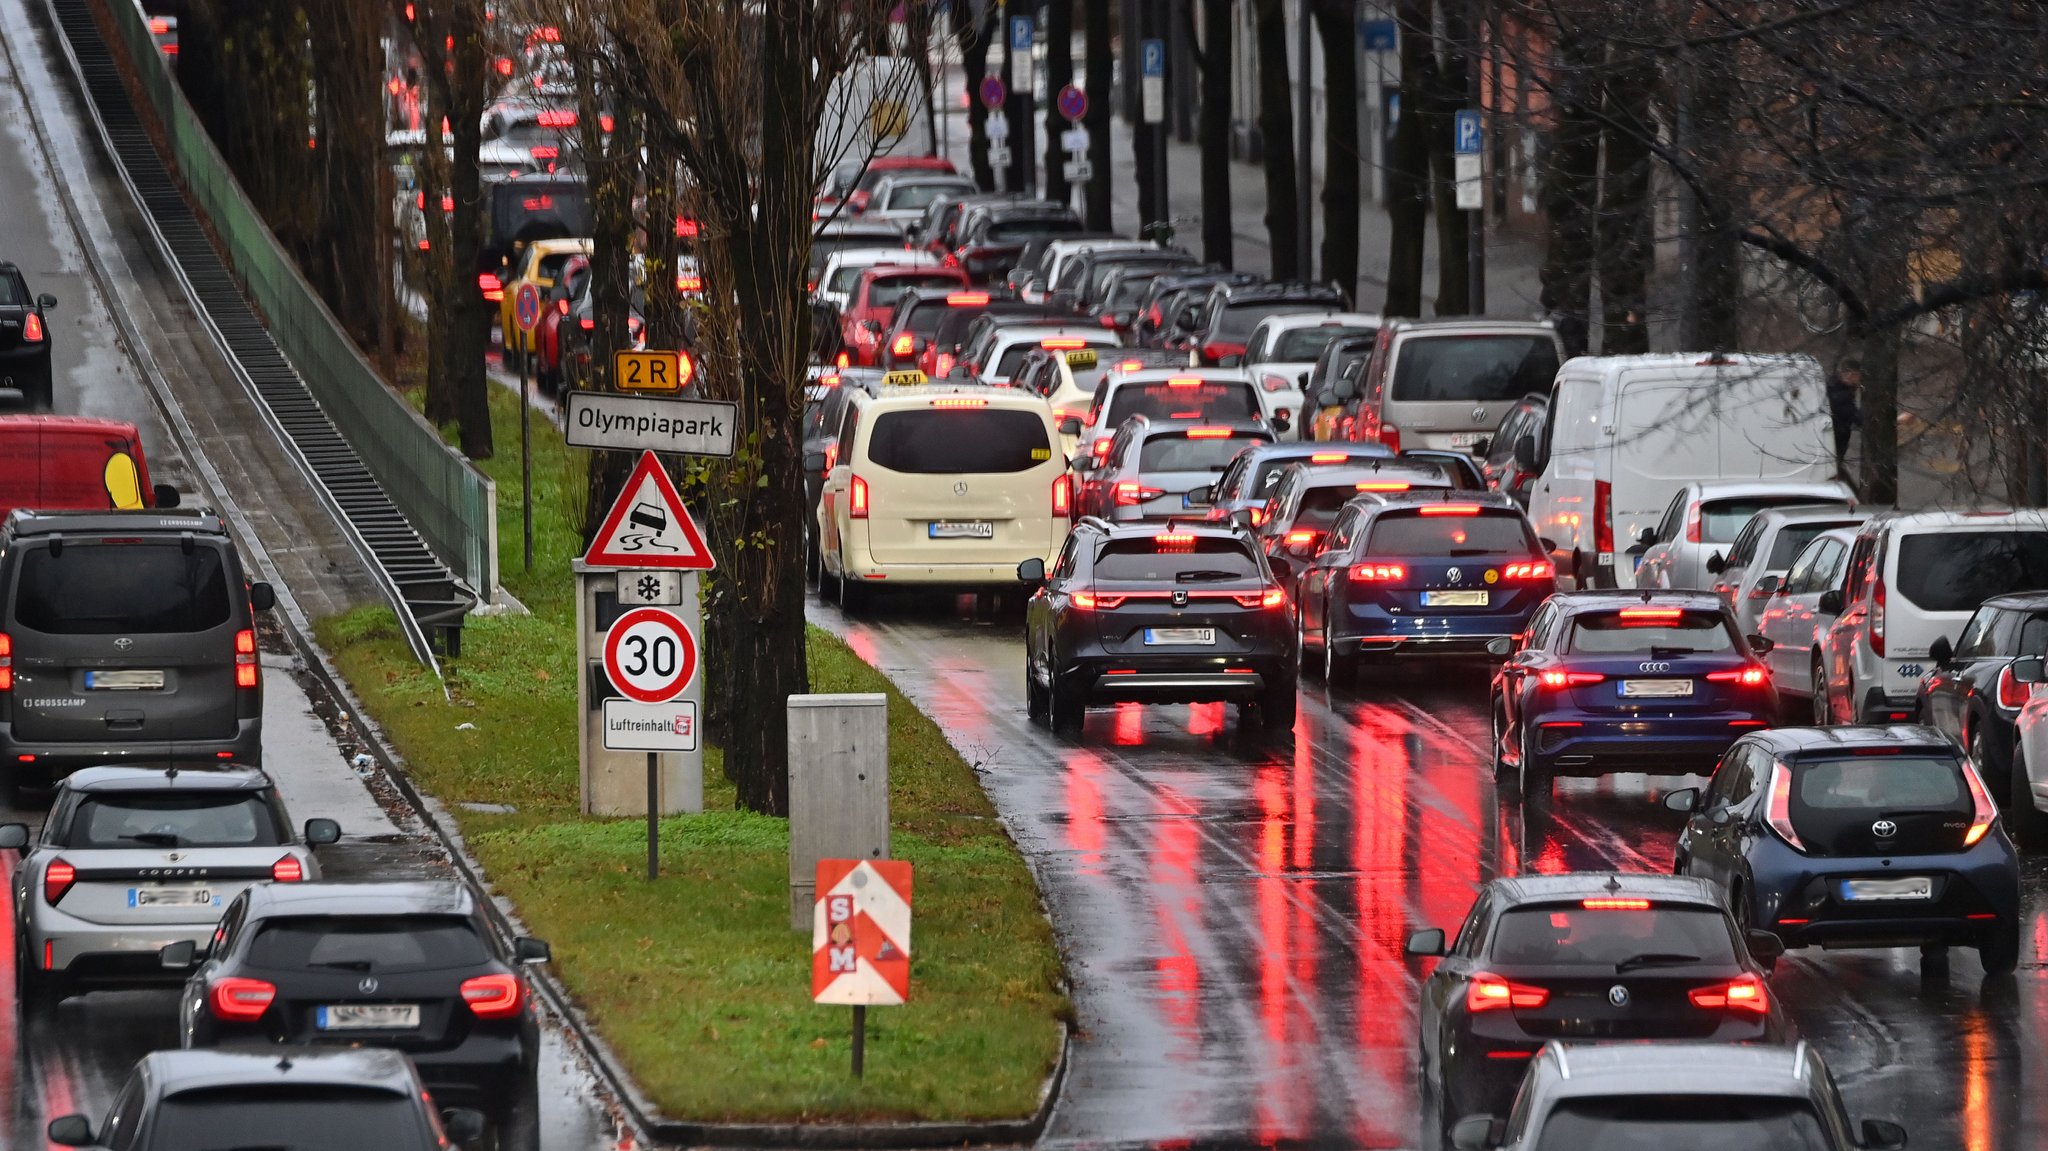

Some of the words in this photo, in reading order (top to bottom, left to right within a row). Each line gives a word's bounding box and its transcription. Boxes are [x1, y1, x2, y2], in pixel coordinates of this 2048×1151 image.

[1461, 117, 1476, 150] P
[627, 359, 641, 383] 2
[649, 359, 667, 383] R
[889, 373, 921, 384] TAXI
[578, 408, 723, 439] Olympiapark
[624, 635, 676, 677] 30
[34, 699, 86, 707] CROSSCAMP
[610, 718, 675, 733] Luftreinhaltu
[138, 868, 208, 876] COOPER
